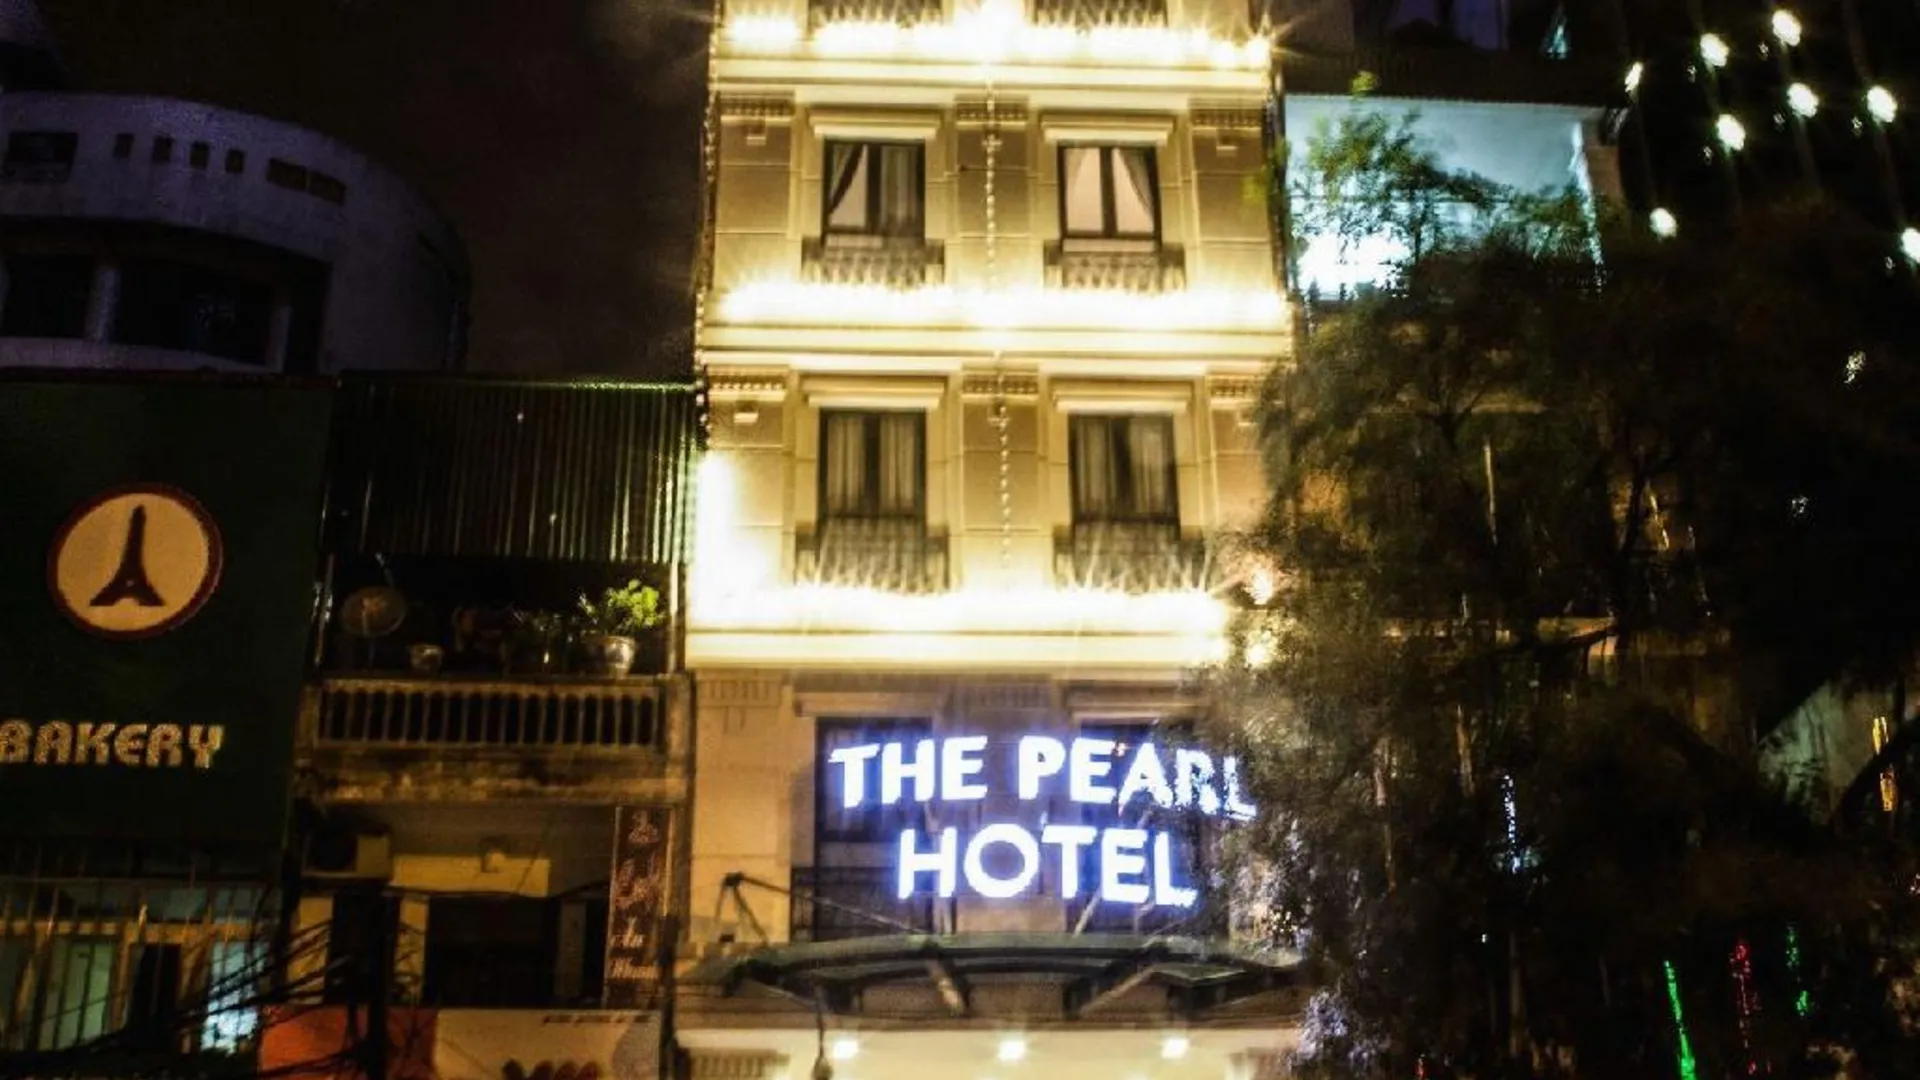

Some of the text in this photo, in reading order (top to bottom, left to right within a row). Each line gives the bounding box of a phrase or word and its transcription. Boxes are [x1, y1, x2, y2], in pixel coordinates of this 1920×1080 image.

[0, 720, 225, 769] BAKERY
[828, 735, 1257, 821] THE PEARL
[898, 823, 1197, 907] HOTEL
